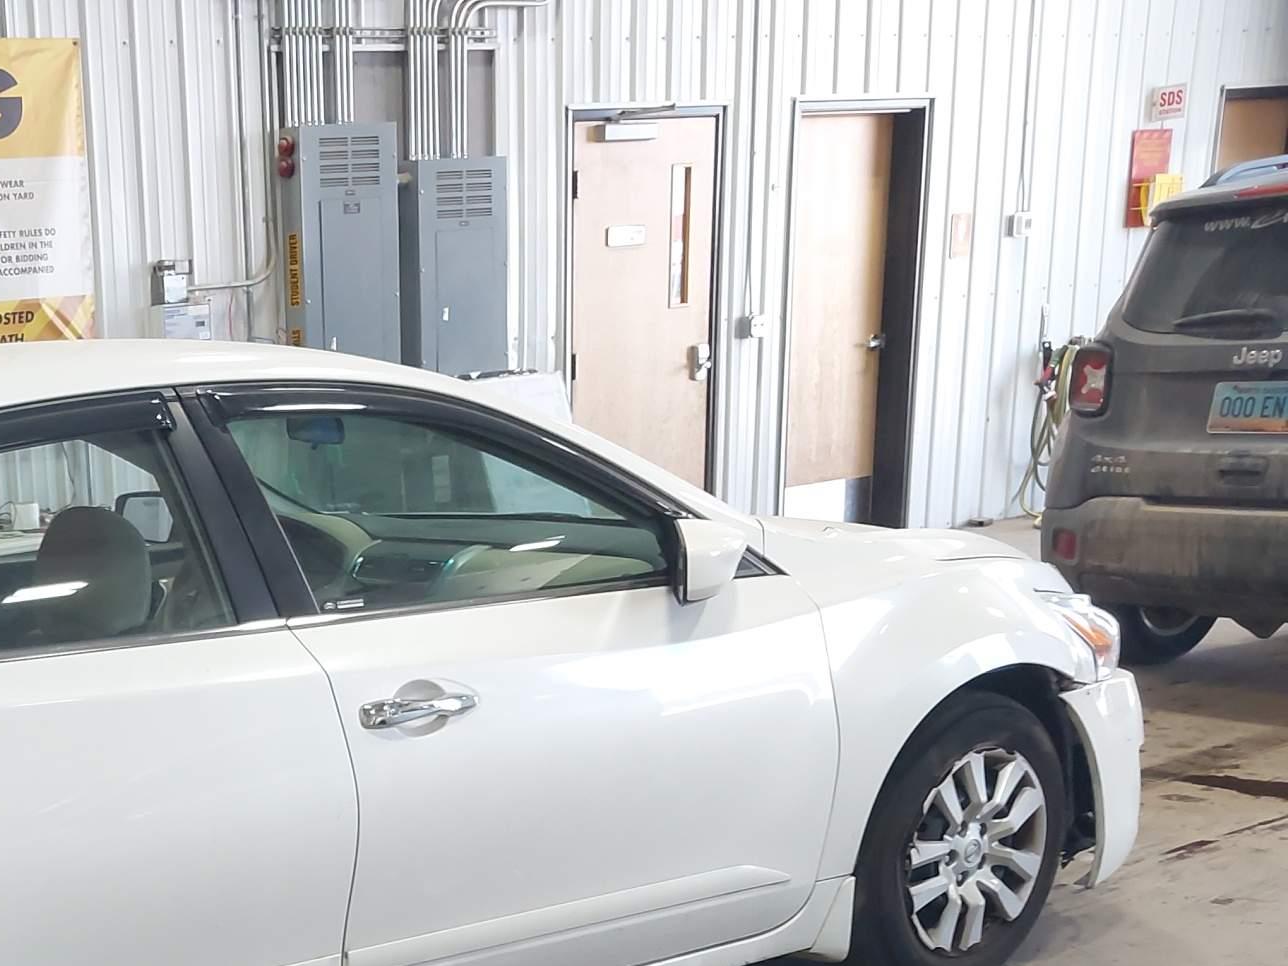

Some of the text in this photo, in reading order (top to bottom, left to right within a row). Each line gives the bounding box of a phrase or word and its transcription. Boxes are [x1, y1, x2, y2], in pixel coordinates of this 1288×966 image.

[1160, 89, 1183, 107] SDS
[13, 192, 34, 201] YARD
[19, 228, 42, 238] RULES
[45, 227, 56, 236] DO
[28, 241, 38, 249] IN
[39, 240, 53, 249] THE
[1, 255, 13, 264] OR
[15, 253, 48, 263] BIDDING
[289, 234, 299, 306] STUDENT DRIVER
[1232, 347, 1282, 368] Jeep
